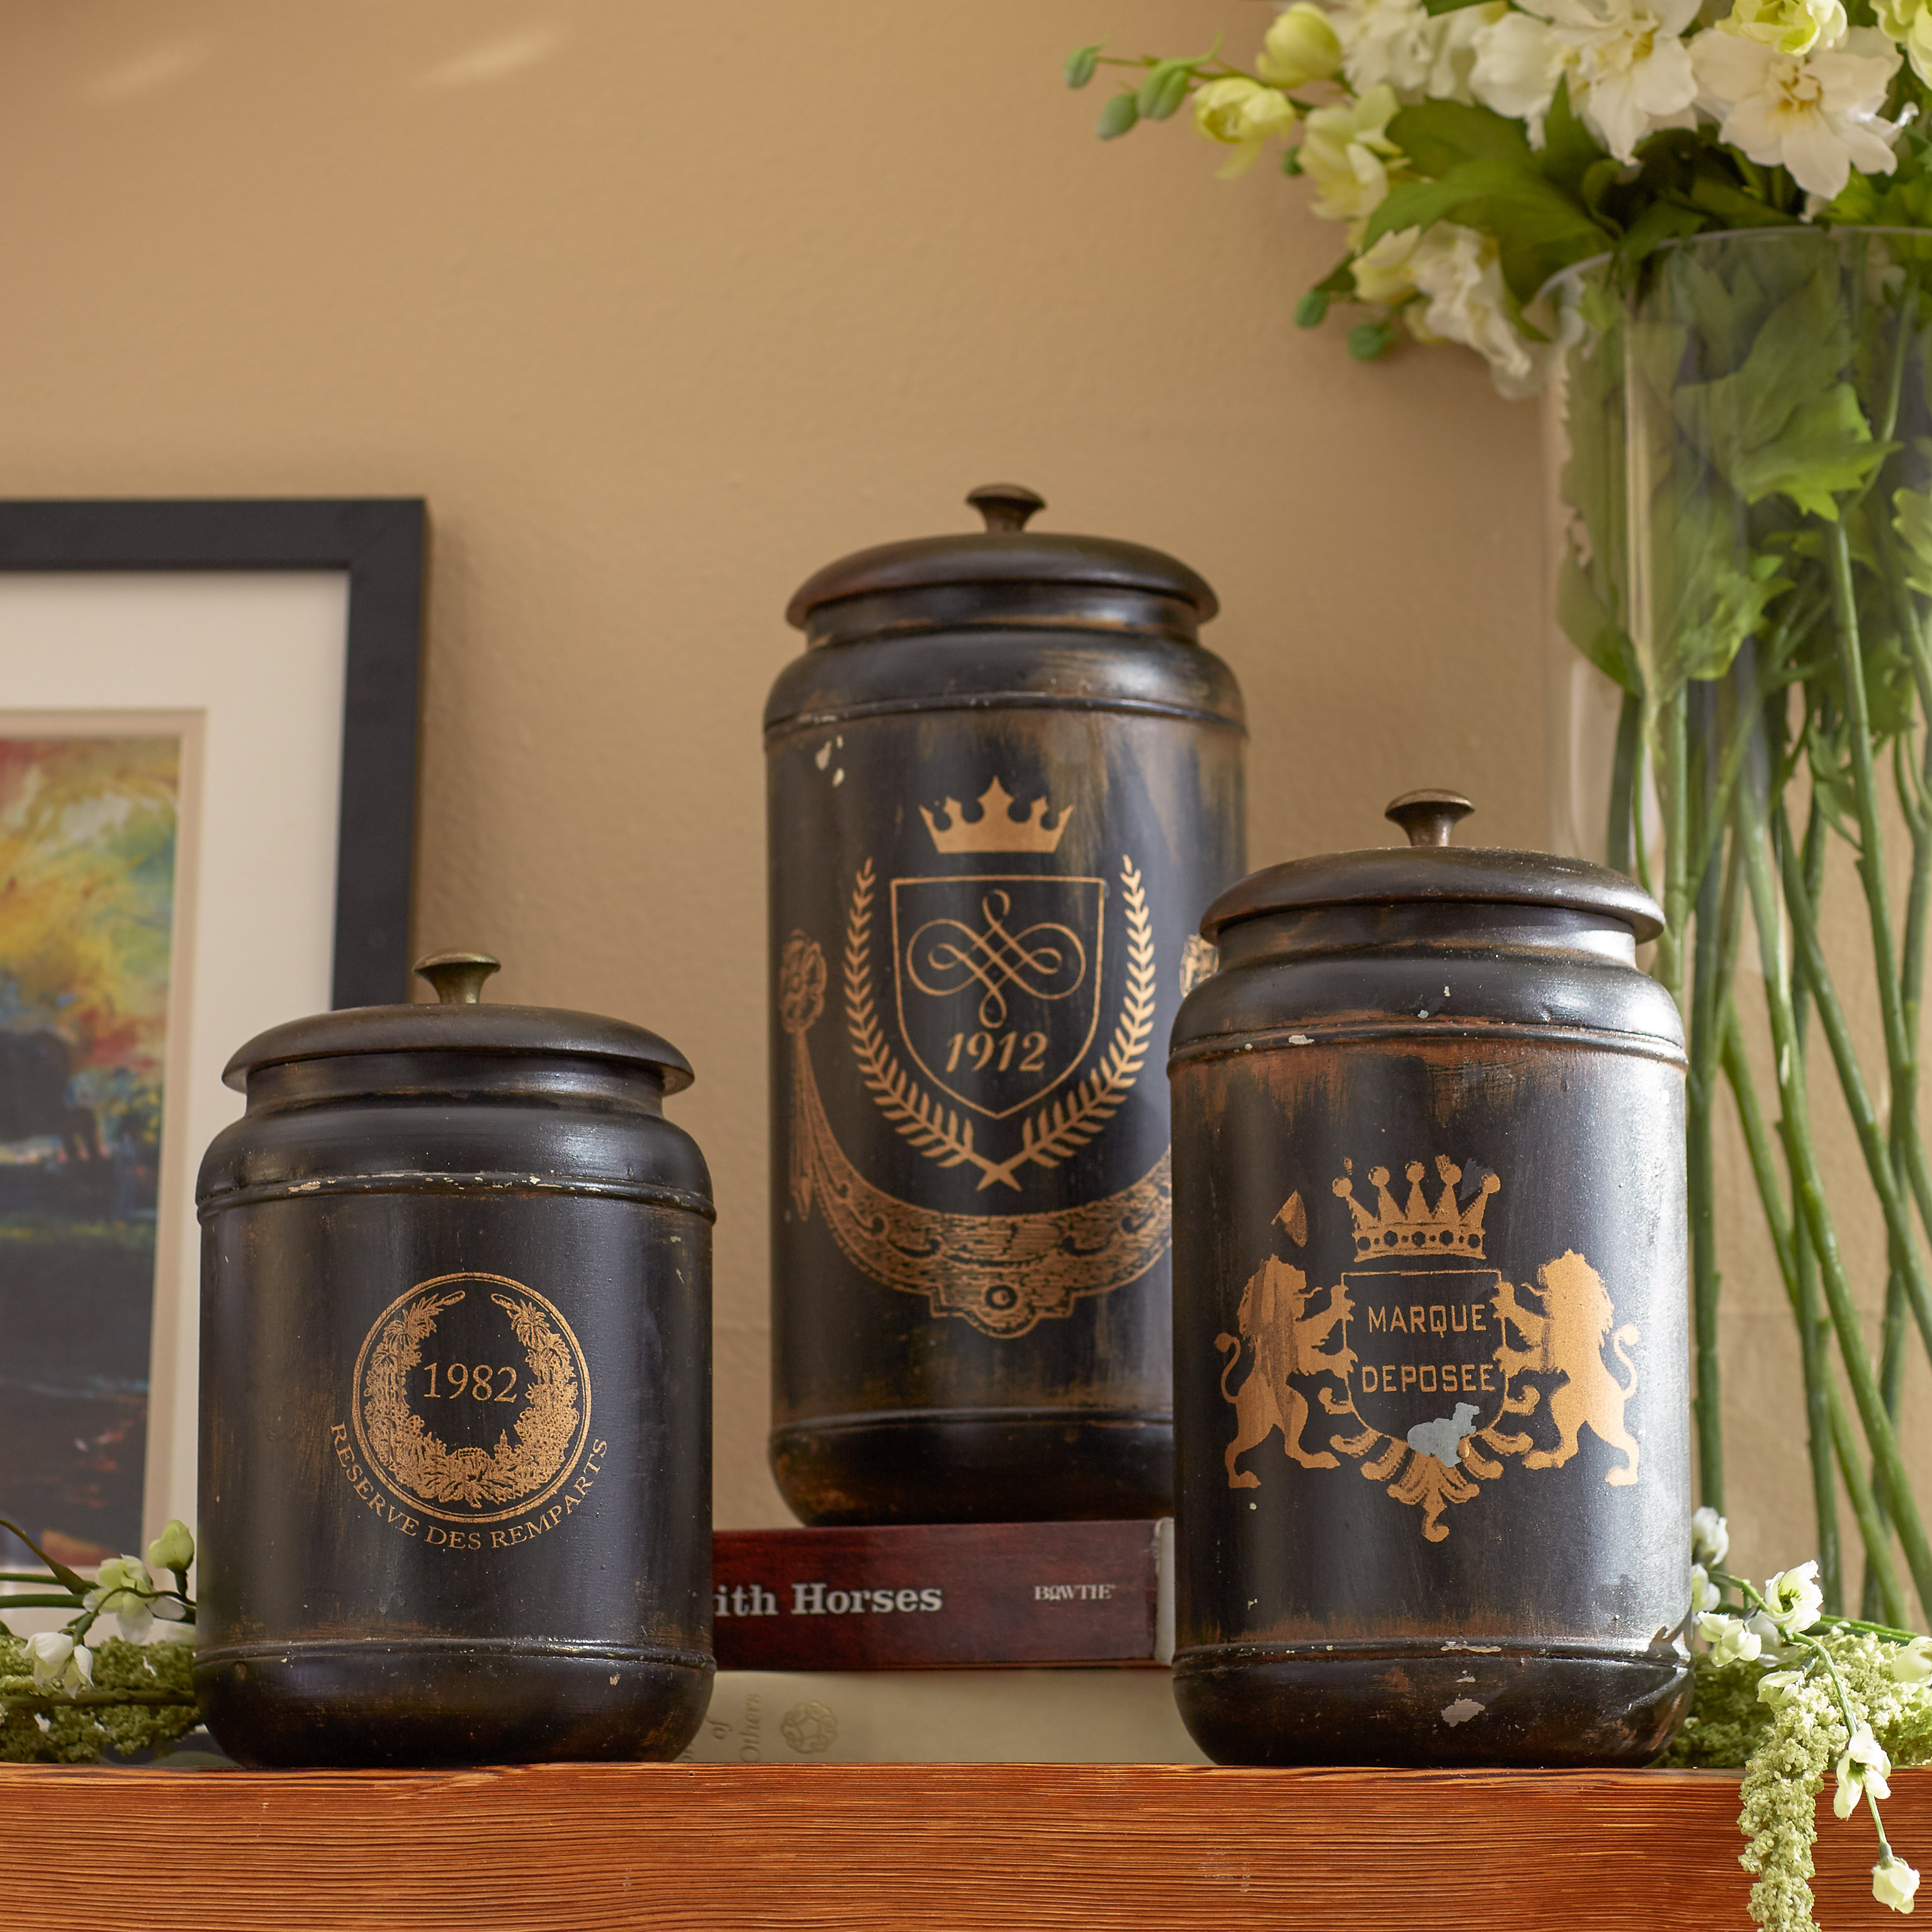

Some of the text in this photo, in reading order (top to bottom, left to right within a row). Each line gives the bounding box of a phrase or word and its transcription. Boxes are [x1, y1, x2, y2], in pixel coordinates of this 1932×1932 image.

[946, 1031, 1048, 1072] 1912
[1368, 1304, 1487, 1338] MARQUE
[423, 1362, 518, 1403] 1982
[1362, 1364, 1496, 1393] DEPOSEE
[330, 1421, 608, 1550] RESERVE DES REMPARTS
[714, 1582, 943, 1617] ith Horses
